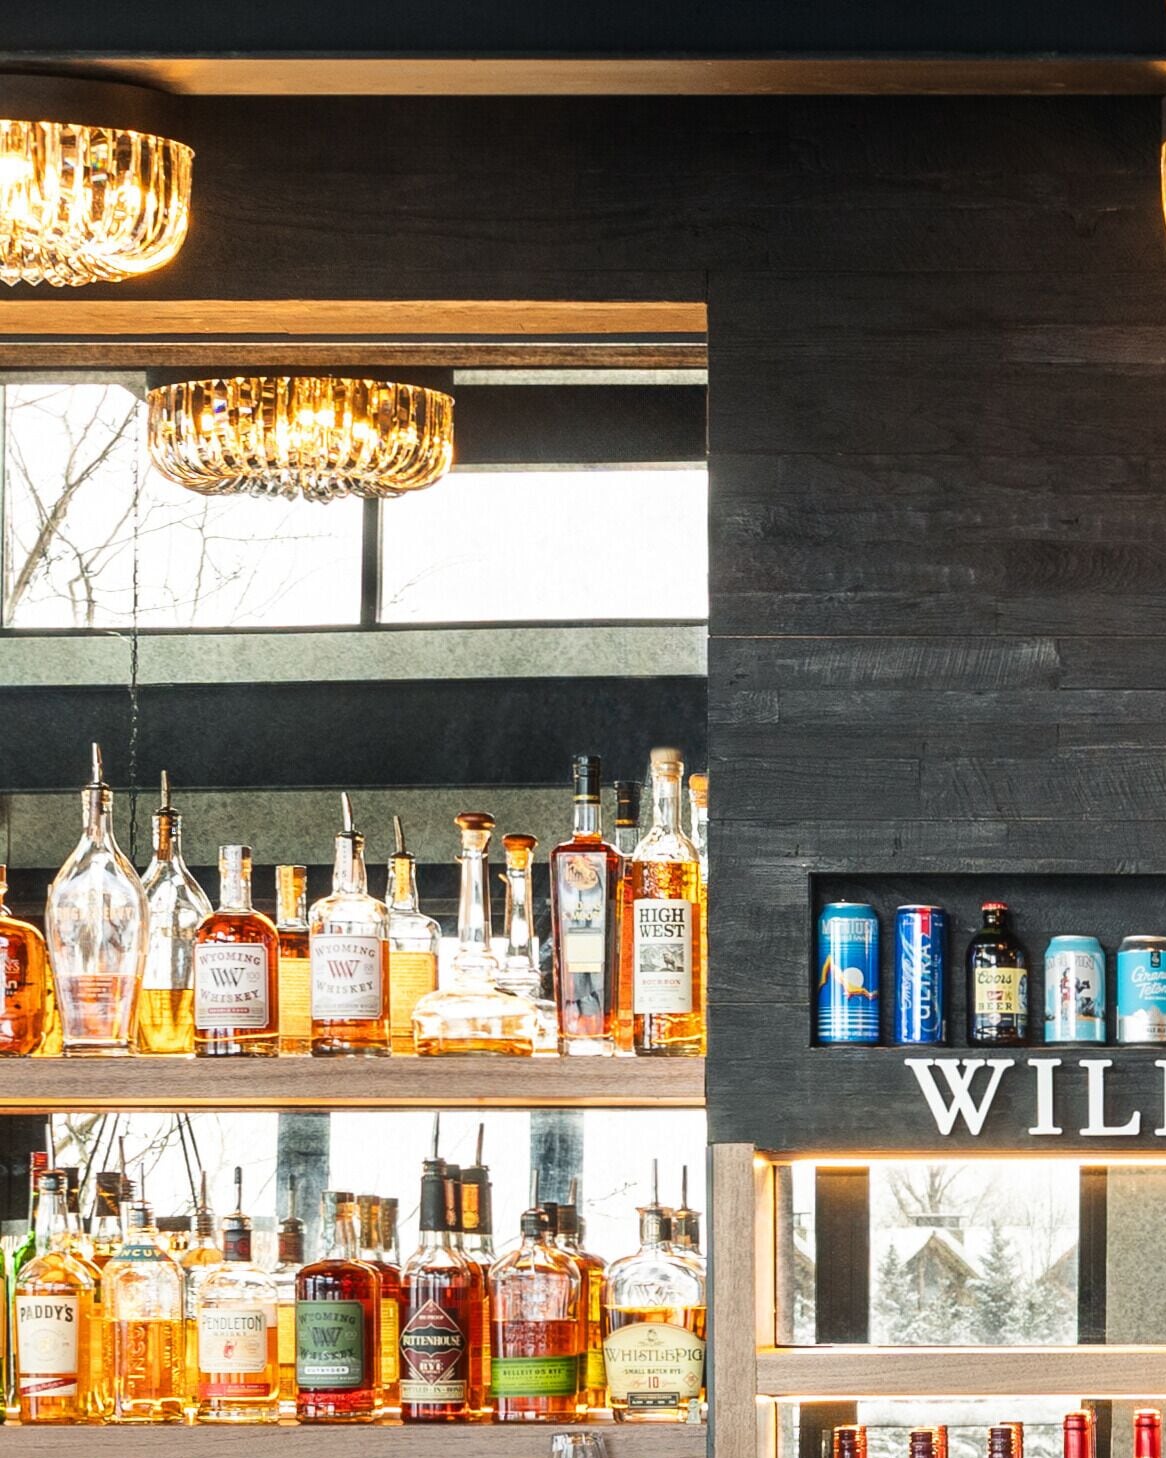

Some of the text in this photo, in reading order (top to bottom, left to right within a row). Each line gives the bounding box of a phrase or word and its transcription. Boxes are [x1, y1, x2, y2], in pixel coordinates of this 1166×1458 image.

[640, 907, 685, 923] HIGH
[640, 924, 685, 938] WEST
[315, 944, 376, 958] WYOMING
[199, 951, 261, 966] WYOMING
[919, 944, 931, 1020] ULTRA
[977, 971, 1012, 984] Coors
[316, 980, 374, 994] WHISKEY
[199, 988, 260, 1003] WHISKEY
[978, 1003, 1013, 1011] BEER
[20, 1303, 74, 1323] PADDY'S
[299, 1311, 357, 1325] WYOMING
[202, 1315, 263, 1331] PENDLETON
[402, 1335, 461, 1347] RITTENHOUSE
[419, 1363, 444, 1371] RYE
[648, 1376, 659, 1389] 10
